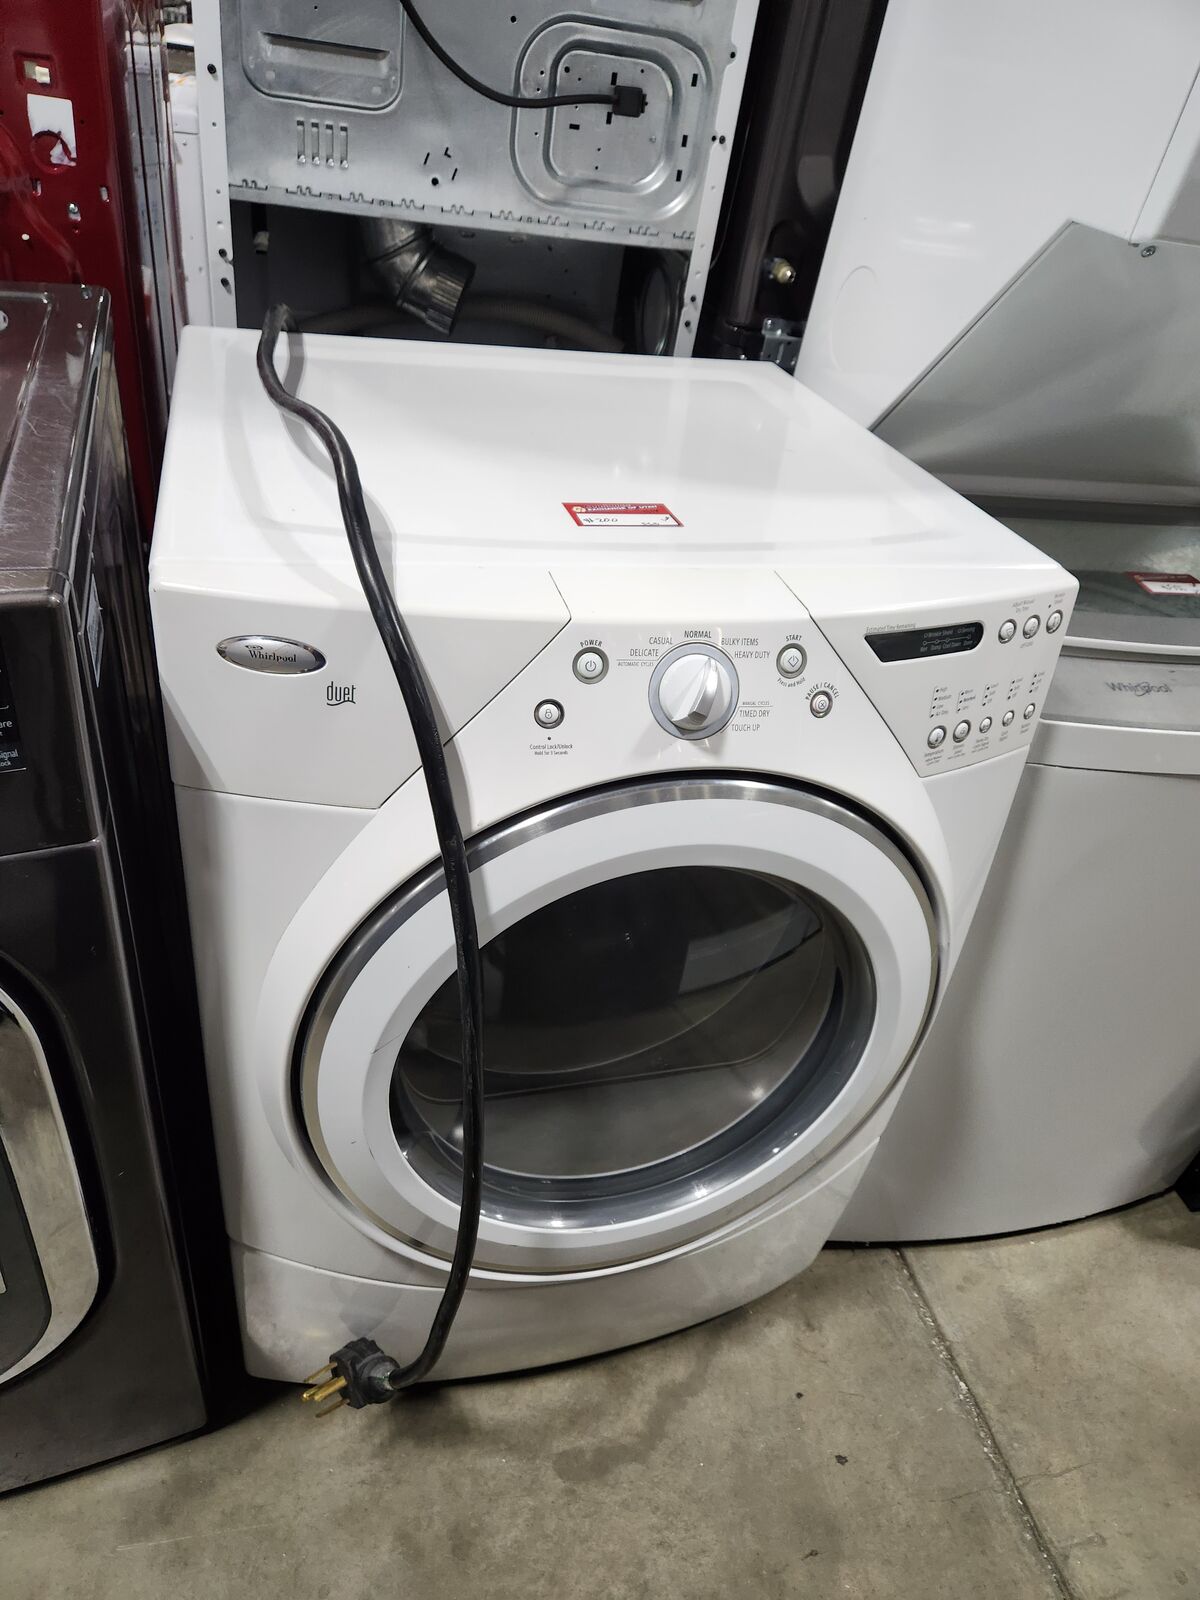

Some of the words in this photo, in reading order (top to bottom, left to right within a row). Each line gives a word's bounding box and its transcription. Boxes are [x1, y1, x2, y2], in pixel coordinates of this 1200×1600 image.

[684, 630, 712, 639] NORMAL
[785, 634, 803, 642] START
[580, 639, 603, 648] POWER
[649, 636, 673, 645] CASUAL
[721, 637, 740, 646] BULKY
[740, 638, 759, 646] ITEMS
[249, 649, 297, 663] Whirlpool
[629, 648, 660, 657] DELICATE
[734, 650, 753, 659] HEAVY
[754, 650, 771, 659] DUTY
[326, 681, 357, 706] duet
[805, 683, 820, 700] PAUSE
[823, 681, 840, 699] CANCEL
[1105, 681, 1173, 697] Whirlpool
[739, 709, 757, 718] TIMED
[758, 709, 771, 718] DRY
[731, 723, 751, 732] TOUCH
[752, 723, 761, 732] UP
